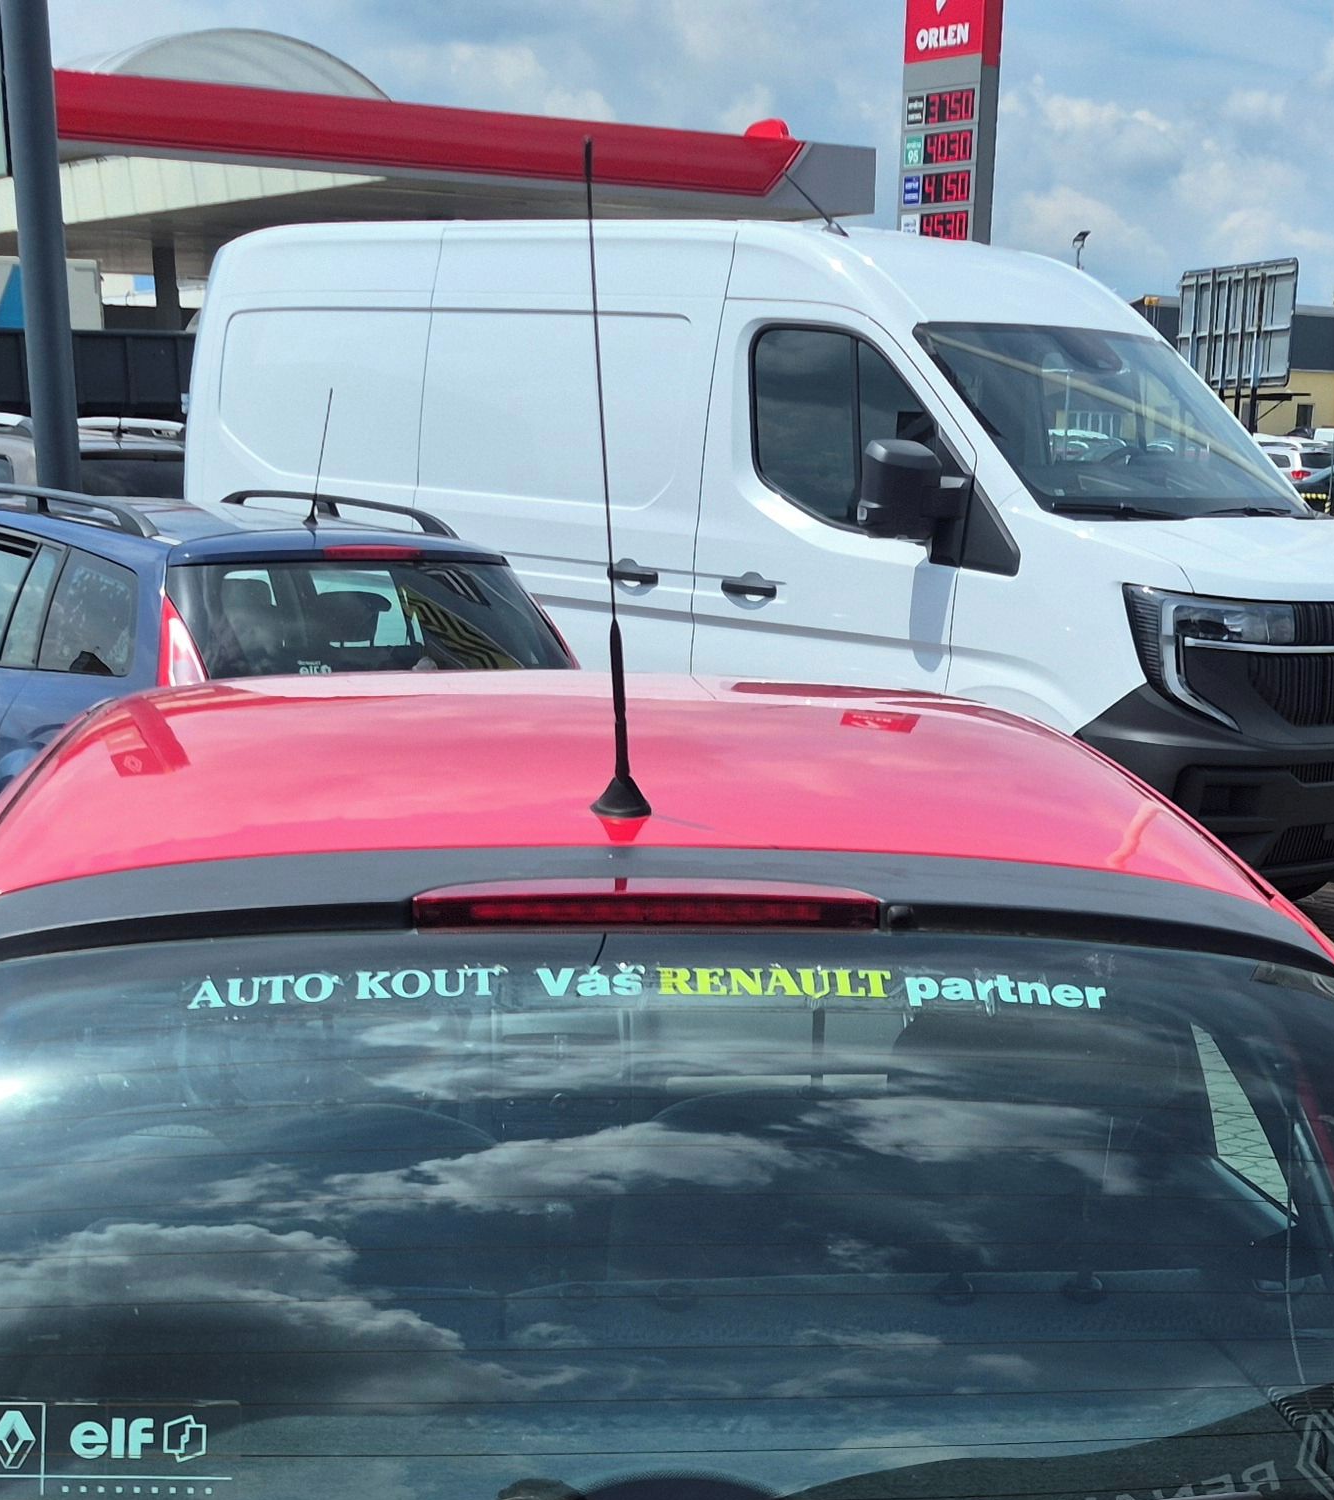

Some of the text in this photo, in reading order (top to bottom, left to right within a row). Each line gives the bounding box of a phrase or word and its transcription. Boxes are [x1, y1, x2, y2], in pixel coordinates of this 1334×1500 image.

[916, 23, 970, 50] ORLEN
[927, 131, 971, 163] 4030
[187, 964, 1107, 1010] AUTO KOUT Váš RENAULT partner
[70, 1417, 154, 1459] elf
